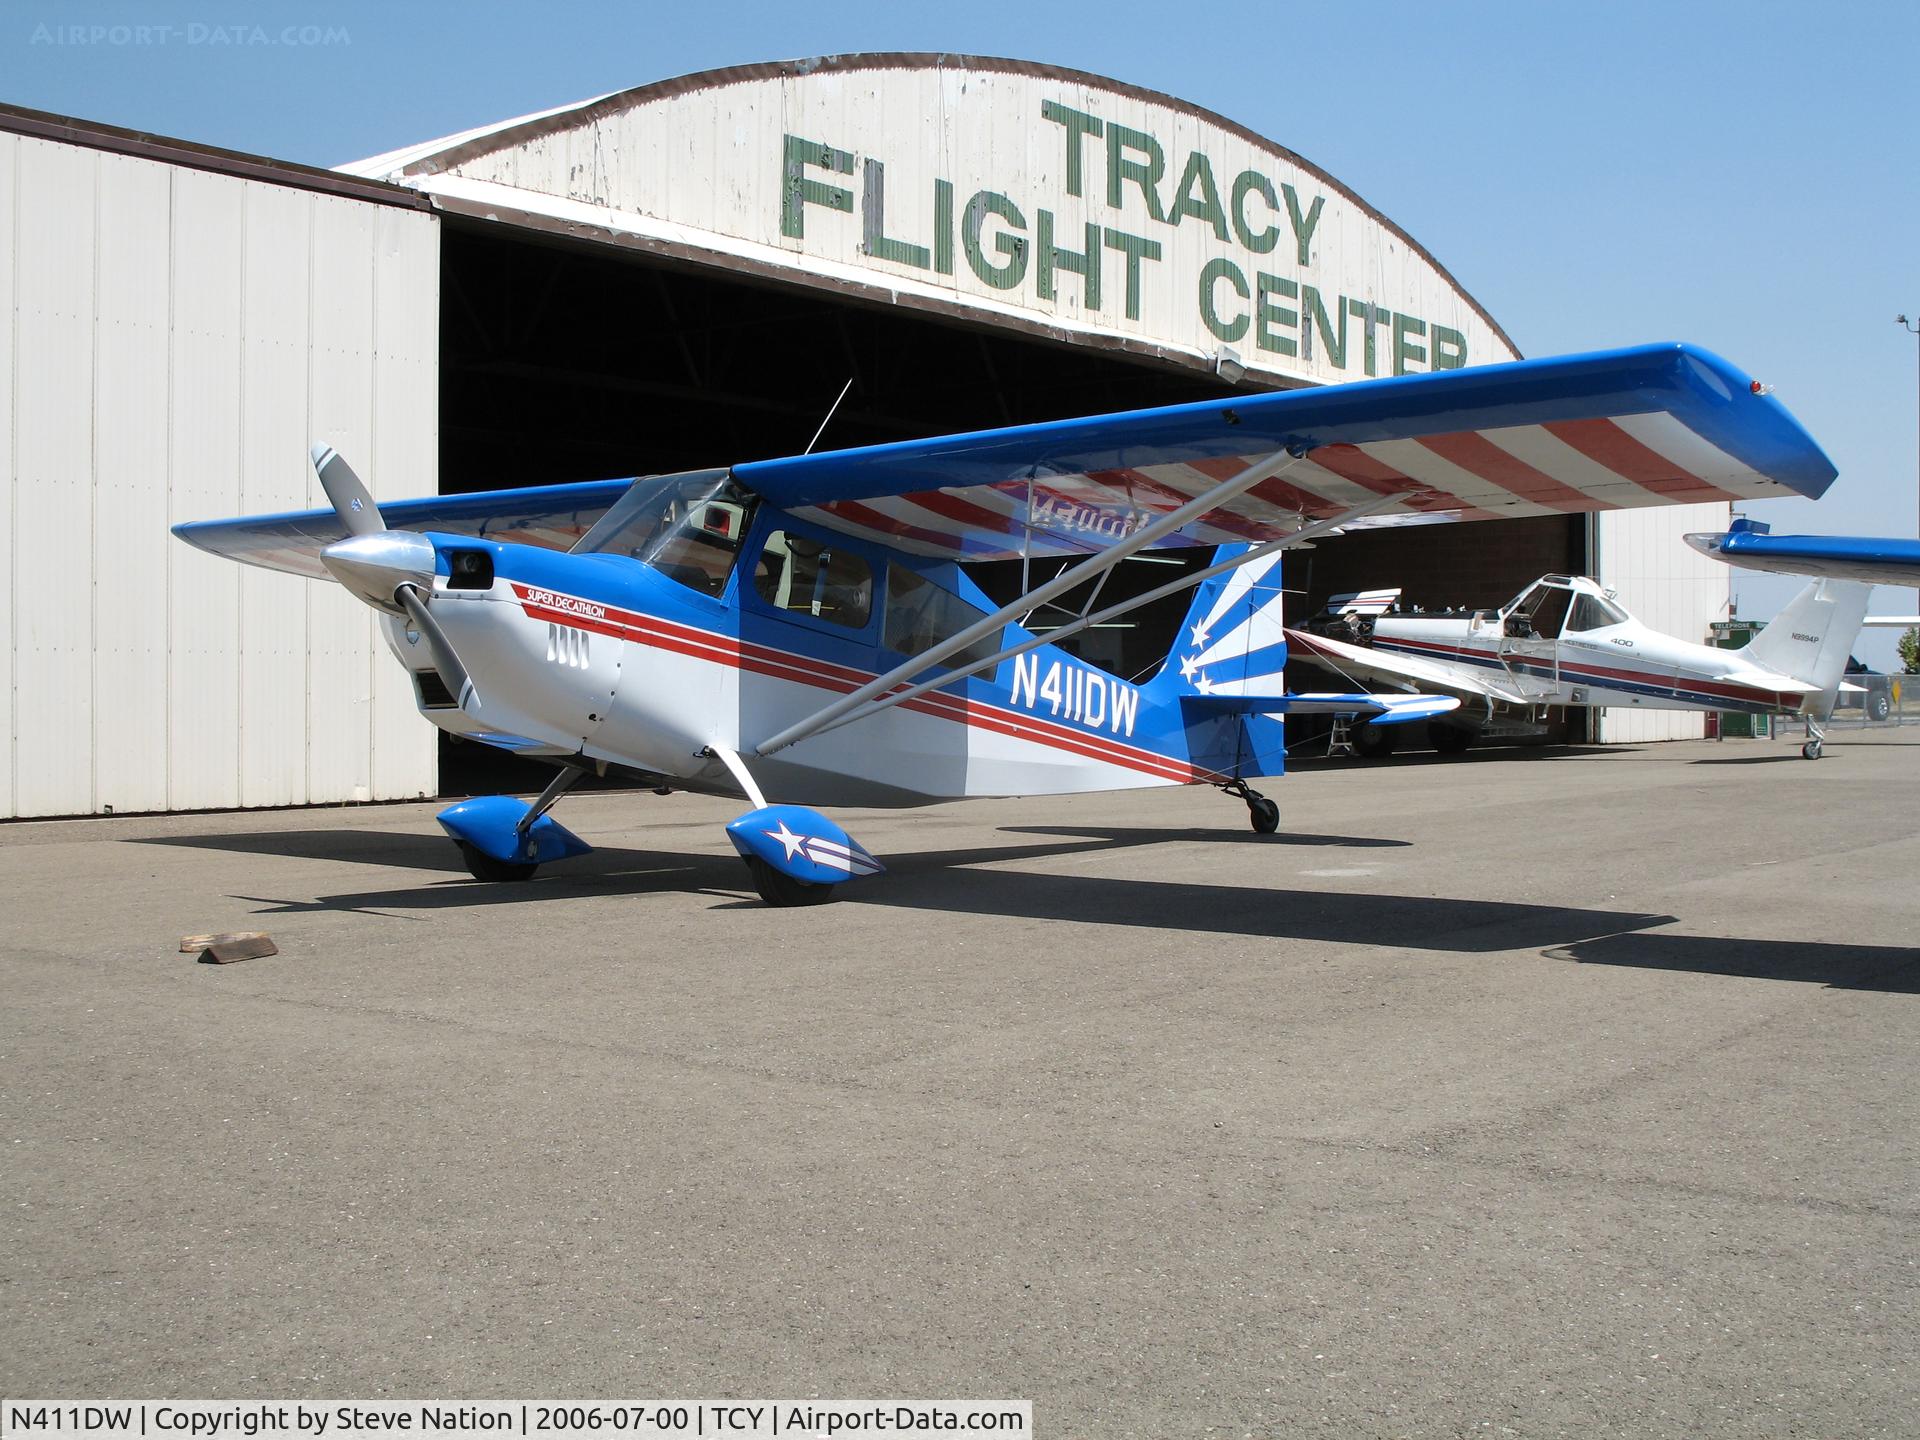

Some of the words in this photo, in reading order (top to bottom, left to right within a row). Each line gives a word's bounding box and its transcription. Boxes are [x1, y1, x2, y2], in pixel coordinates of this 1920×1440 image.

[1041, 98, 1326, 266] TRACY
[782, 134, 1162, 320] FLIGHT
[526, 589, 554, 606] SUPER
[555, 597, 605, 618] DECATHLON
[1610, 638, 1634, 648] 400
[1009, 653, 1139, 737] N411DW
